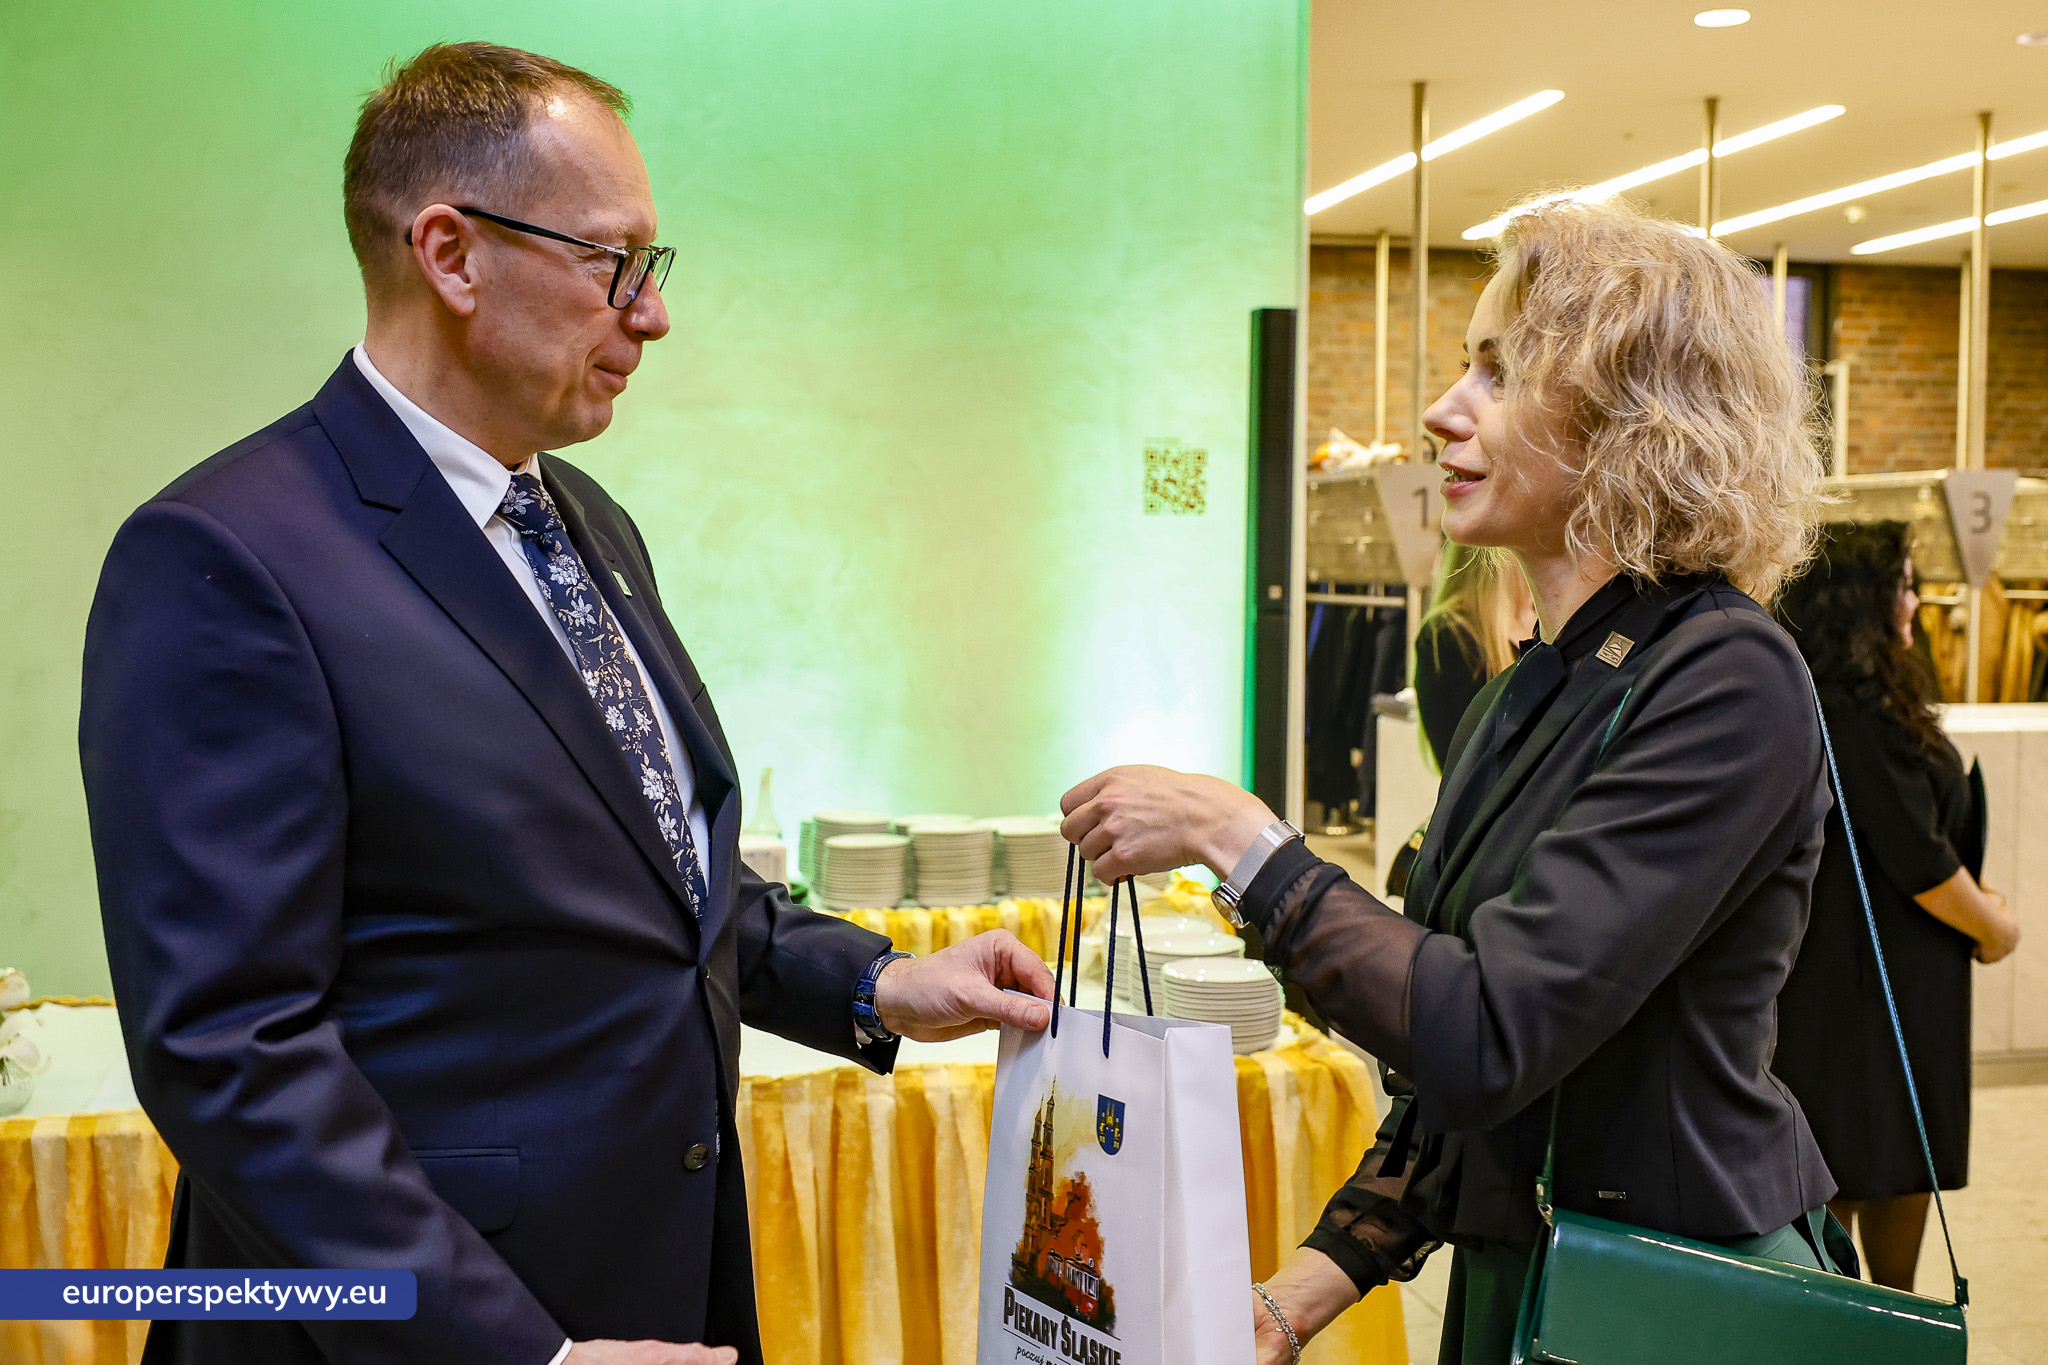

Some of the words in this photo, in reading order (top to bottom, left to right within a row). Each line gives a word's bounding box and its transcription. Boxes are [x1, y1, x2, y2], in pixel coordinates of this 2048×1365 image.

[1413, 487, 1428, 529] 1
[1970, 490, 1992, 535] 3
[1003, 1286, 1059, 1350] PIEKARY
